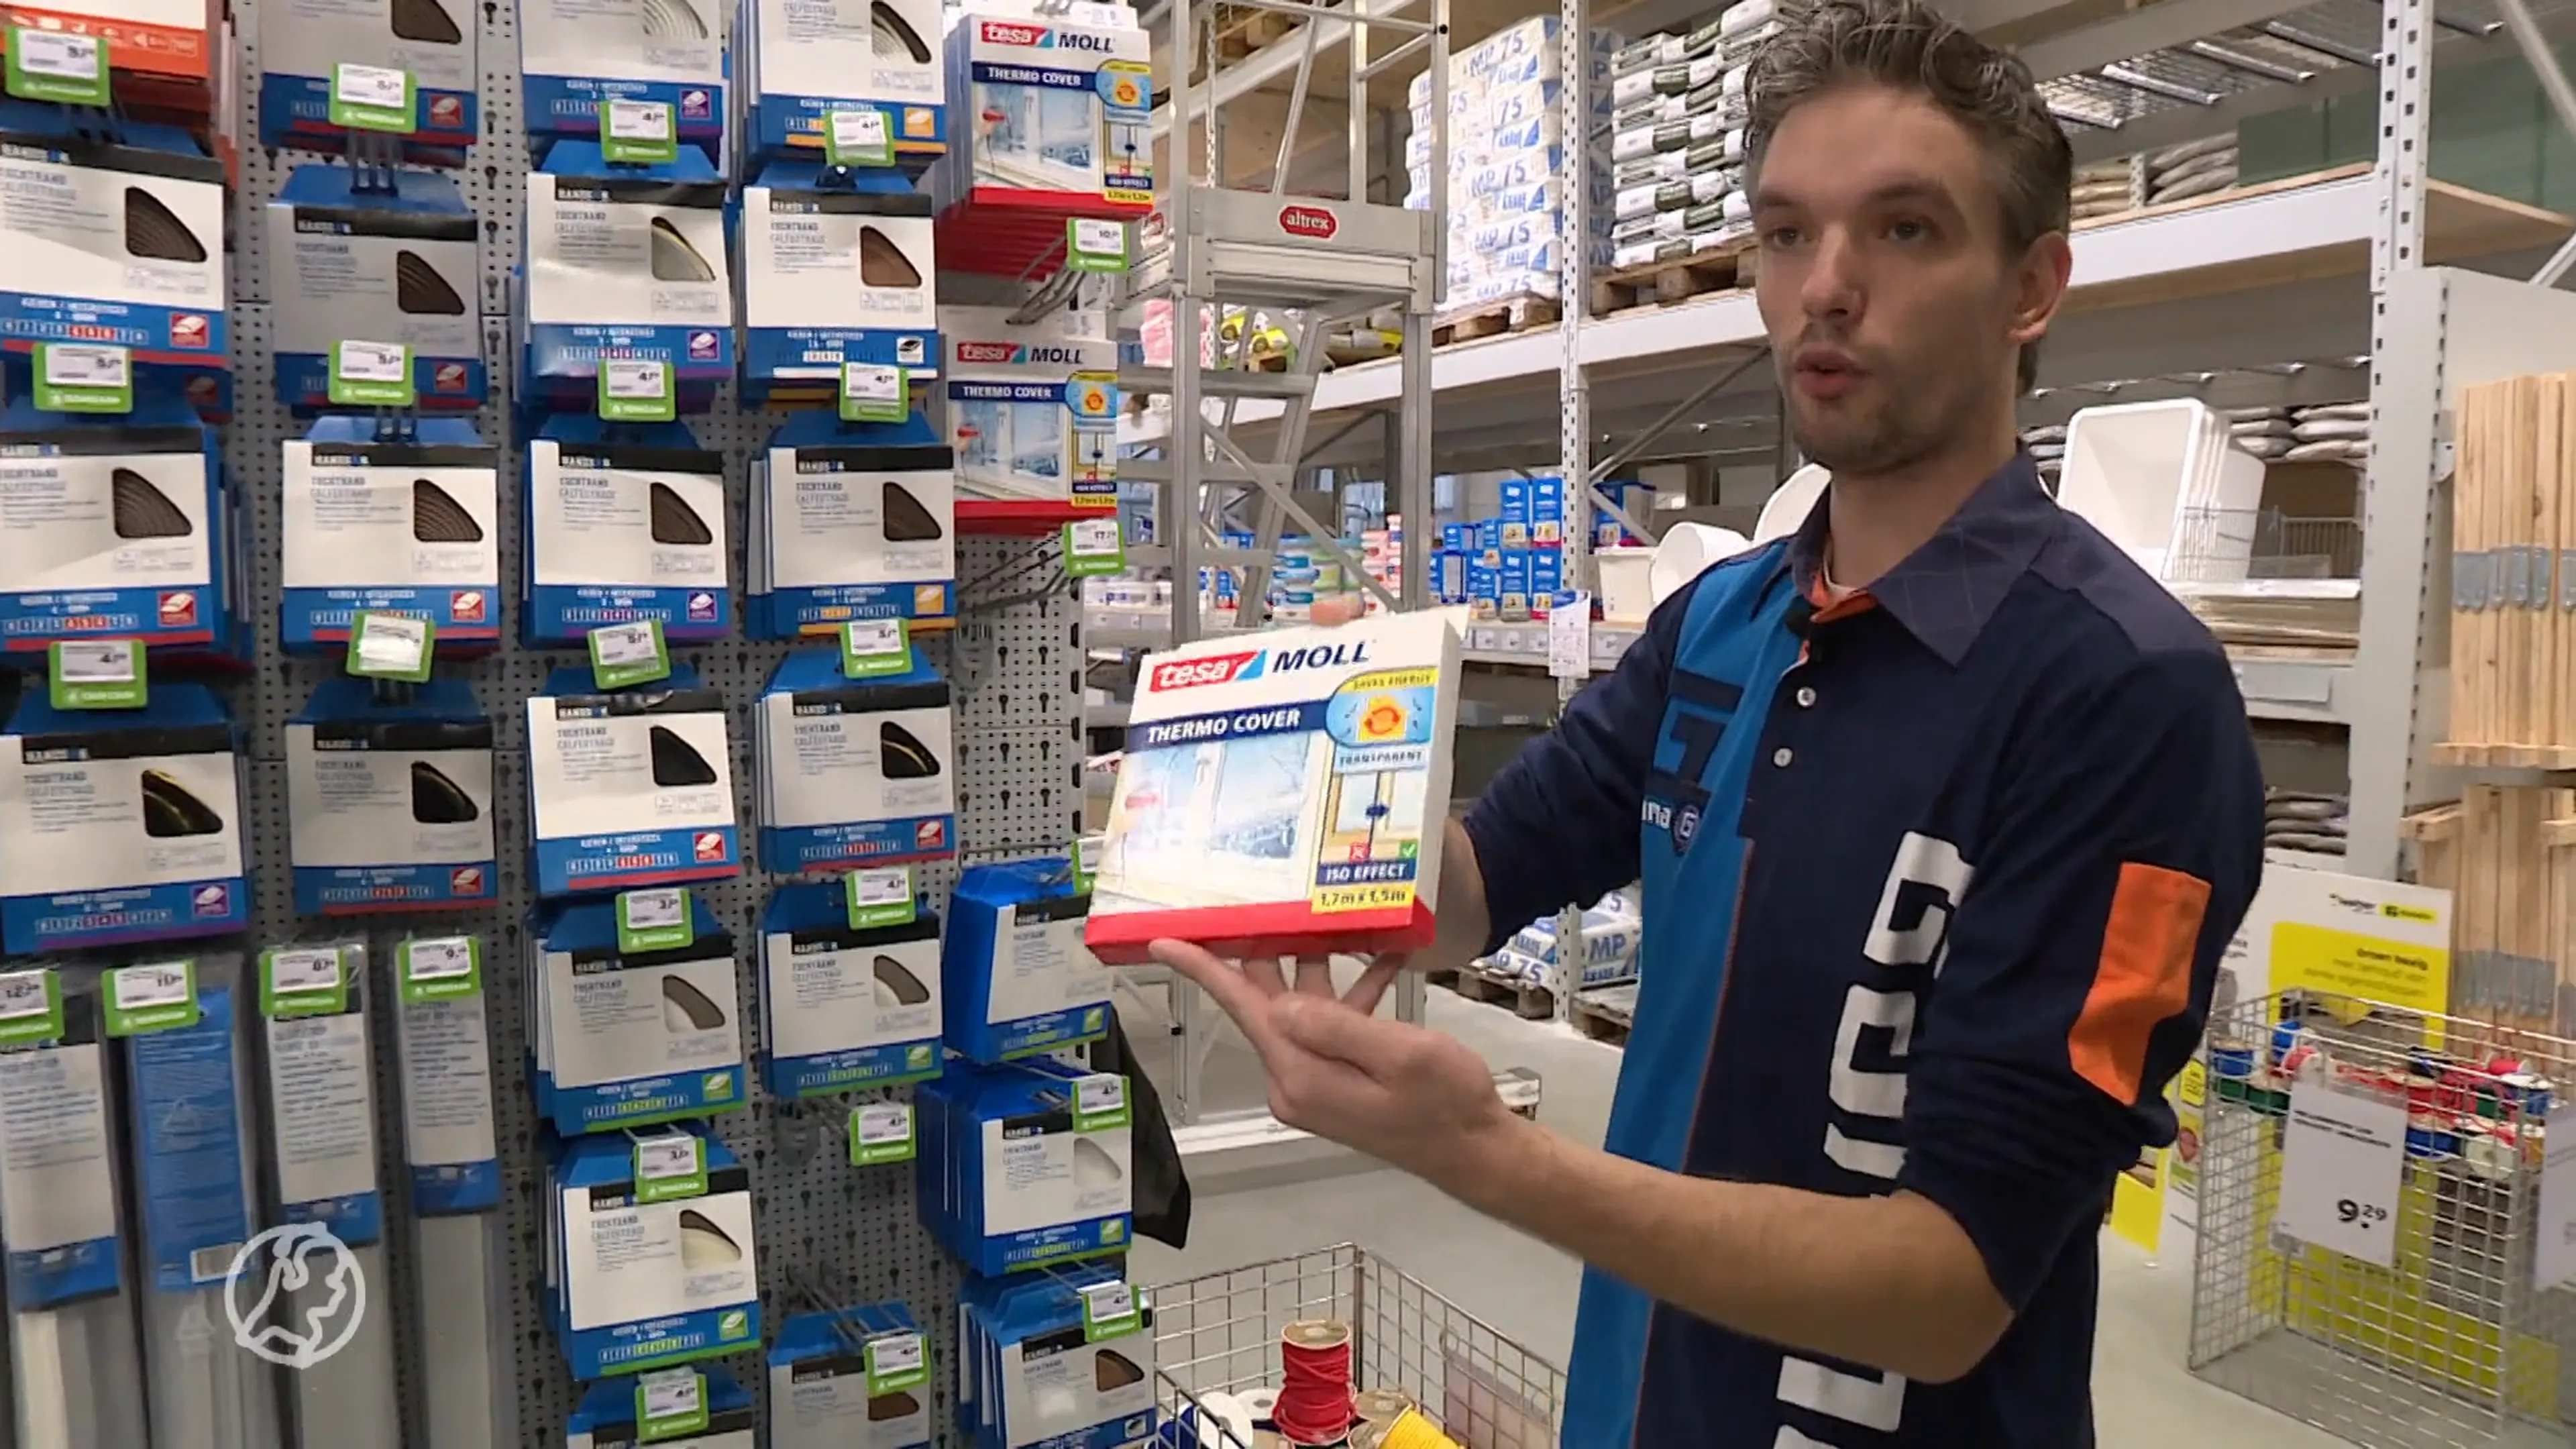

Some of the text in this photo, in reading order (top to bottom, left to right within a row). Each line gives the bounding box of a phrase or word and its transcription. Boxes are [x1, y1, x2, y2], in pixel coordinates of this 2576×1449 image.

[987, 25, 1114, 53] tesa MOLL
[988, 67, 1081, 85] THERMO COVER
[1287, 209, 1329, 229] altrex
[962, 344, 1082, 364] tesa MOLL
[963, 386, 1052, 398] THERMO COVER
[1159, 641, 1368, 687] tesa MOLL
[1148, 708, 1301, 743] THERMO COVER
[1354, 863, 1407, 880] EFFECT
[1591, 933, 1626, 961] MP
[1519, 958, 1543, 983] 75
[2337, 1199, 2387, 1230] 9.29
